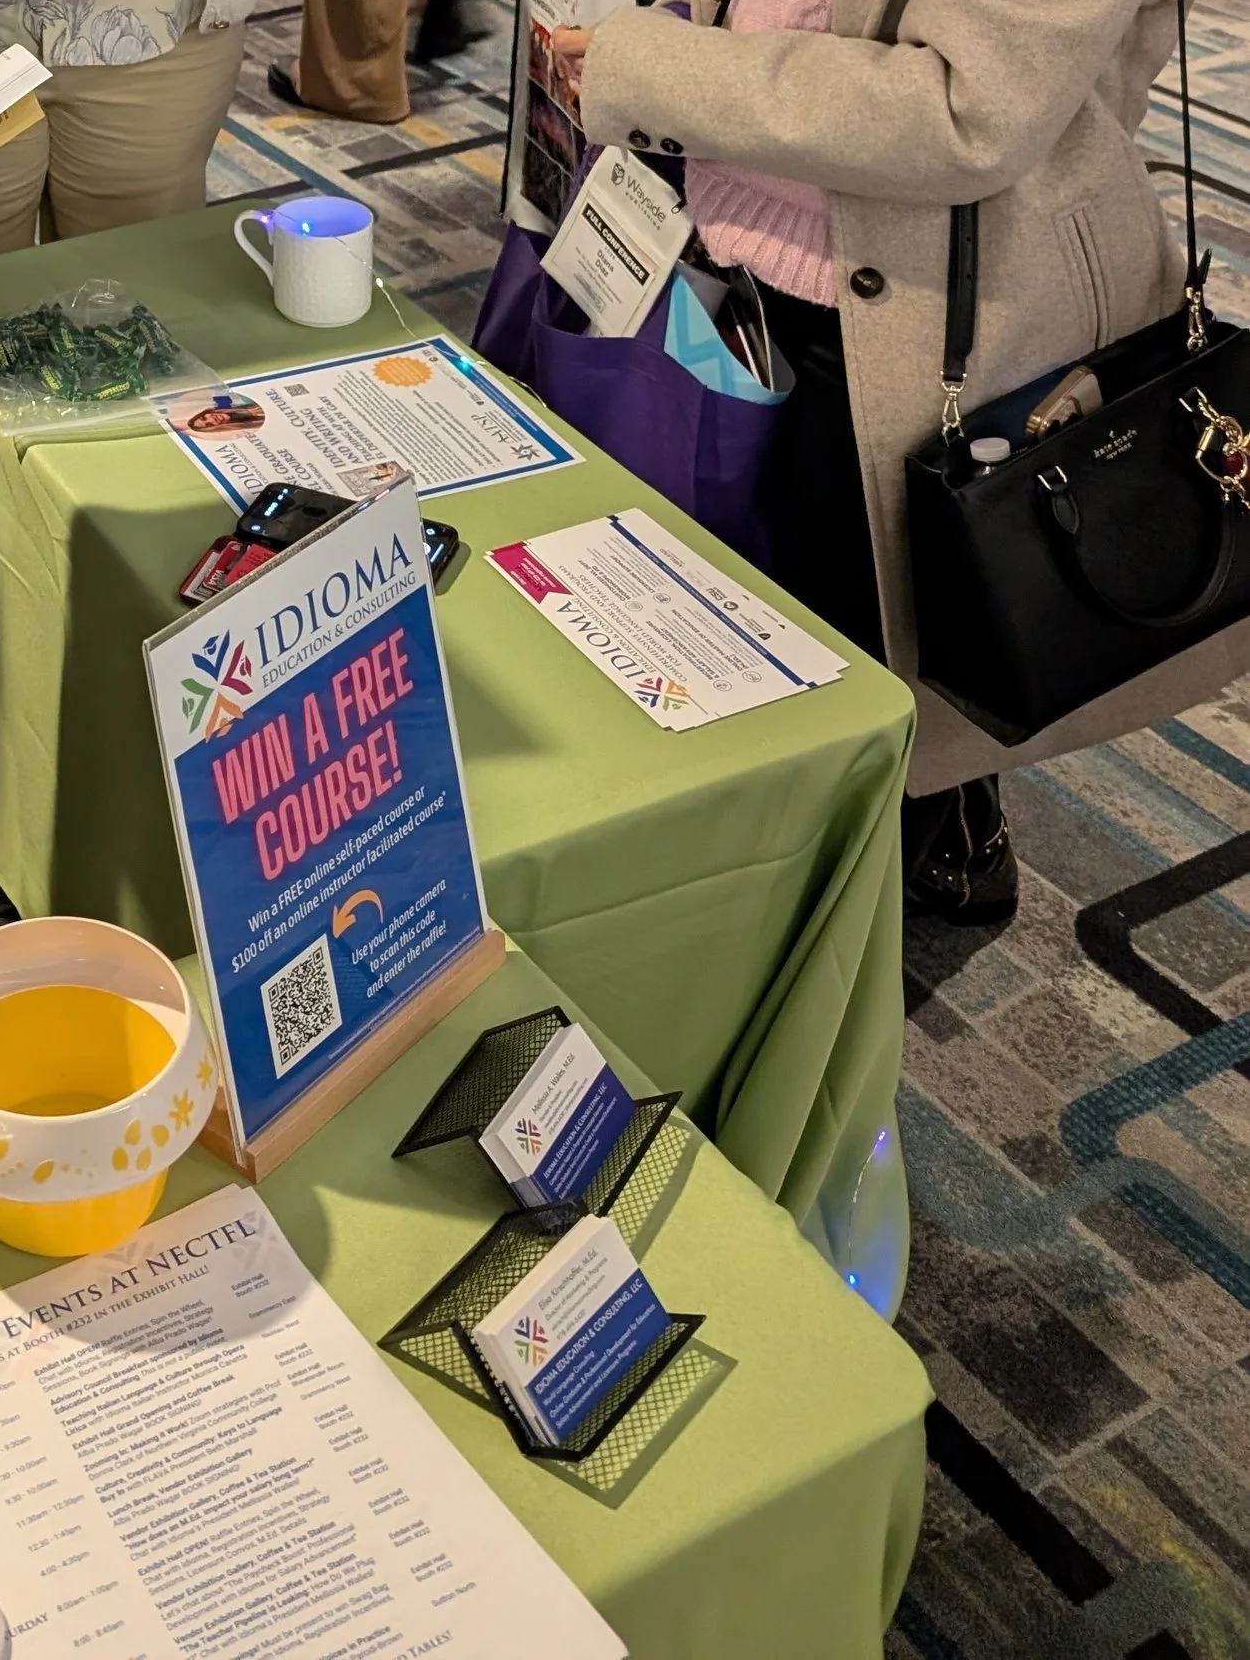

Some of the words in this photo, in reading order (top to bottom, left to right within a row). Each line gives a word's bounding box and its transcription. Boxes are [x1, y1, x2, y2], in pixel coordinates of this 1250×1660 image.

[625, 177, 666, 222] Wayside
[586, 211, 603, 228] FULL
[602, 231, 646, 279] CONFERENCE
[595, 260, 610, 277] Diaz
[597, 250, 615, 272] Diana
[265, 388, 305, 427] CULTURE,
[300, 408, 344, 448] WRITING
[316, 407, 336, 423] WITH
[331, 423, 346, 431] AP
[276, 449, 312, 480] COURSE
[301, 427, 346, 468] IDENTITY,
[338, 446, 363, 464] AND
[341, 431, 375, 462] TEACHING
[207, 568, 226, 587] VISA
[255, 533, 413, 668] IDIOMA
[262, 630, 332, 688] EDUCATION
[335, 623, 344, 638] &
[345, 571, 416, 629] CONSULTING
[557, 601, 646, 679] IDIOMA
[568, 598, 619, 634] CONSULTING
[617, 639, 661, 673] EDUCATION
[213, 715, 295, 823] WIN
[304, 693, 329, 764] A
[333, 628, 413, 739] FREE
[256, 721, 401, 880] COURSE!
[248, 909, 270, 932] Win
[271, 904, 278, 916] a
[278, 879, 304, 910] FREE
[304, 858, 335, 889] online
[336, 815, 384, 865] self-paced
[385, 796, 415, 826] course
[415, 786, 425, 802] or
[232, 942, 257, 973] $100
[258, 928, 273, 951] off
[274, 922, 287, 939] an
[288, 896, 320, 928] online
[319, 857, 366, 902] instructor
[366, 816, 414, 865] facilitated
[352, 945, 368, 965] Use
[368, 928, 388, 955] your
[389, 906, 415, 938] phone
[415, 879, 446, 912] camera
[370, 959, 379, 973] to
[380, 941, 400, 965] scan
[400, 927, 417, 947] this
[416, 910, 436, 933] code
[367, 973, 384, 998] and
[384, 957, 406, 983] enter
[406, 945, 421, 963] the
[421, 920, 446, 951] raffle!
[2, 1284, 103, 1337] EVENTS
[111, 1267, 140, 1294] AT
[145, 1220, 256, 1276] NECTFL
[8, 1347, 20, 1359] AT
[23, 1323, 69, 1351] BOOTH
[66, 1315, 92, 1332] #232
[93, 1308, 108, 1320] IN
[108, 1298, 132, 1313] THE
[132, 1279, 176, 1303] EXHIBIT
[177, 1264, 209, 1284] HALL!
[534, 1369, 558, 1394] IDIOMA
[555, 1333, 590, 1372] EDUCATION
[593, 1291, 633, 1331] CONSULTING,
[630, 1278, 643, 1294] LLC
[72, 1434, 98, 1450] Exhibit
[96, 1426, 116, 1440] Hall
[116, 1416, 140, 1431] Grand
[140, 1403, 172, 1420] Opening
[187, 1385, 212, 1399] Coffee
[212, 1374, 235, 1388] Break
[407, 1630, 451, 1658] TABLES!
